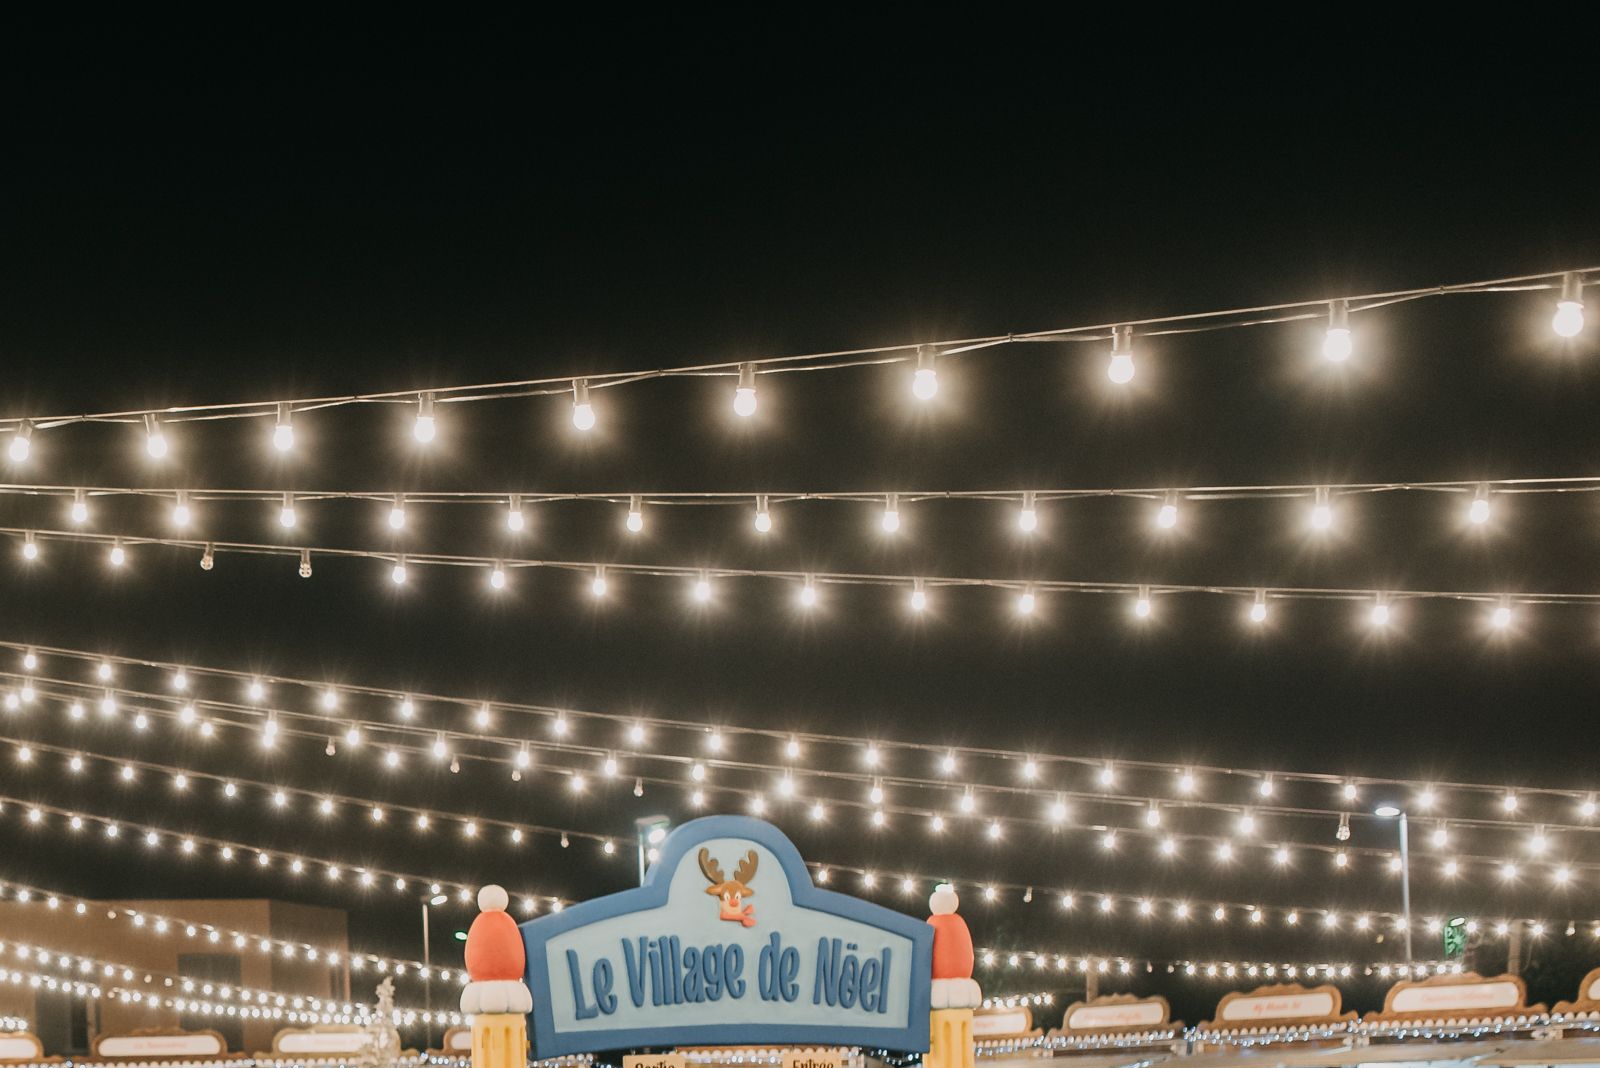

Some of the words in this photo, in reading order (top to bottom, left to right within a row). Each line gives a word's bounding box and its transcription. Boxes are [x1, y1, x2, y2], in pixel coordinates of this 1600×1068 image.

[566, 949, 619, 1021] Le
[621, 934, 747, 1008] Village
[758, 931, 800, 1003] de
[813, 936, 892, 1014] Nöel
